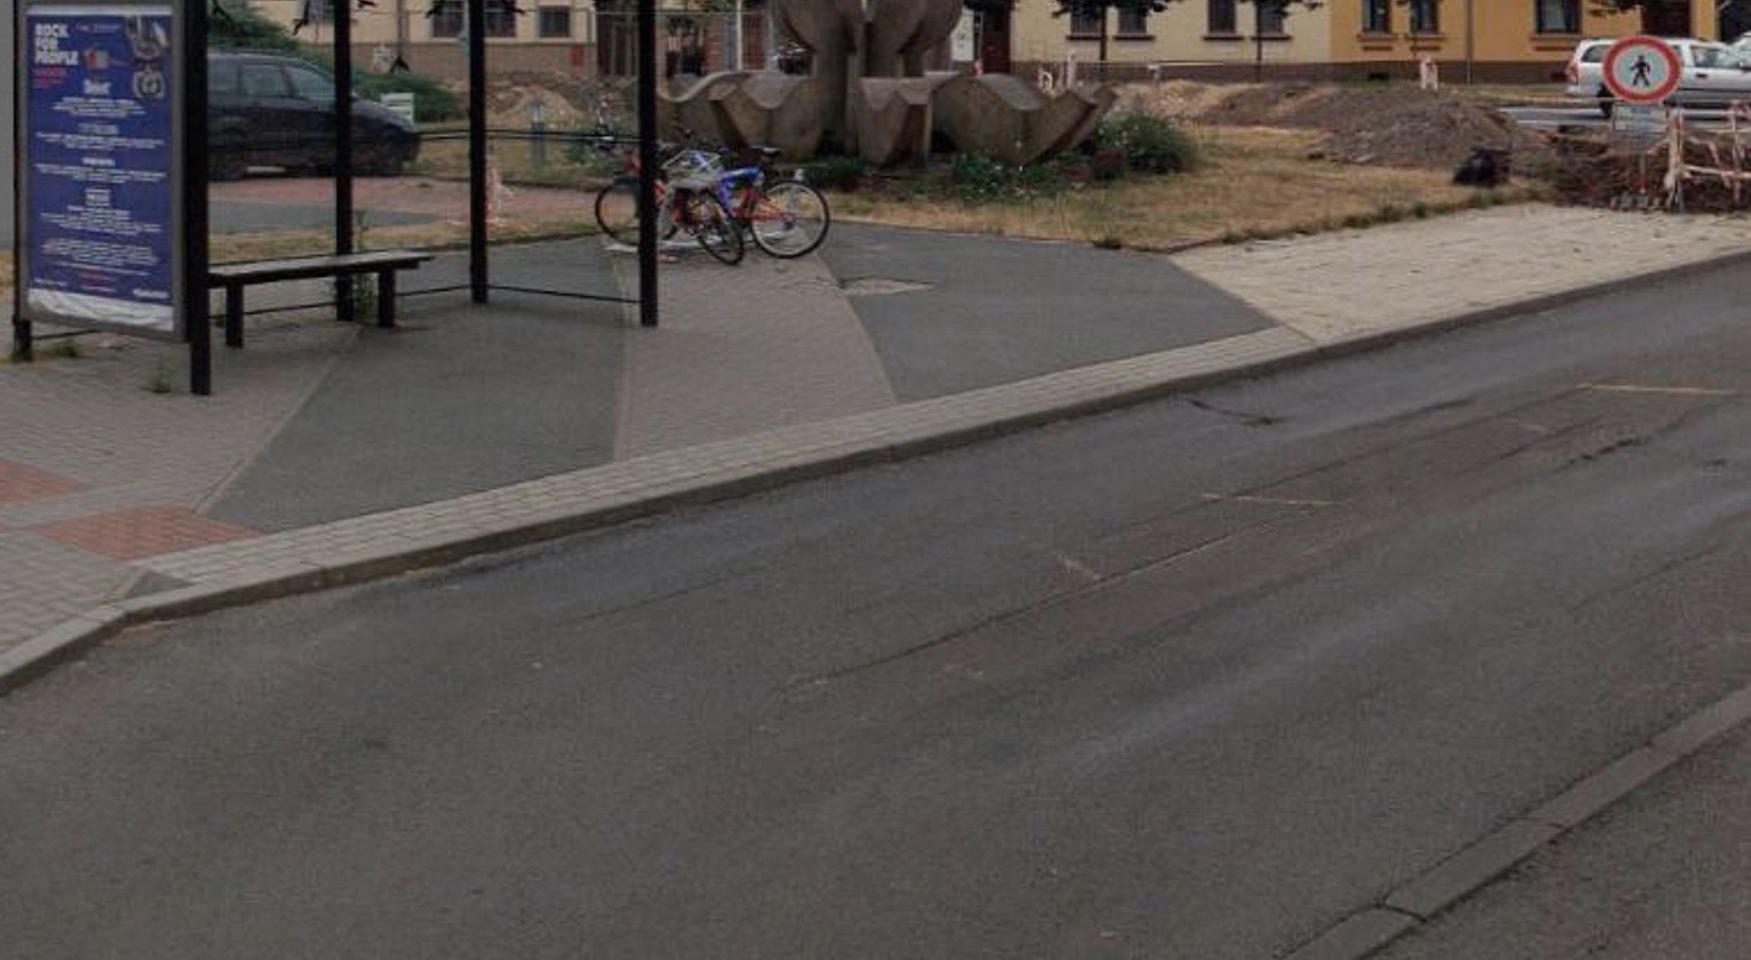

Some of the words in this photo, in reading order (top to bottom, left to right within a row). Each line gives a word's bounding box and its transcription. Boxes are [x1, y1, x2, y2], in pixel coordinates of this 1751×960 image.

[35, 23, 69, 38] ROCK
[35, 38, 59, 51] FOR
[35, 51, 79, 65] PEOPLE
